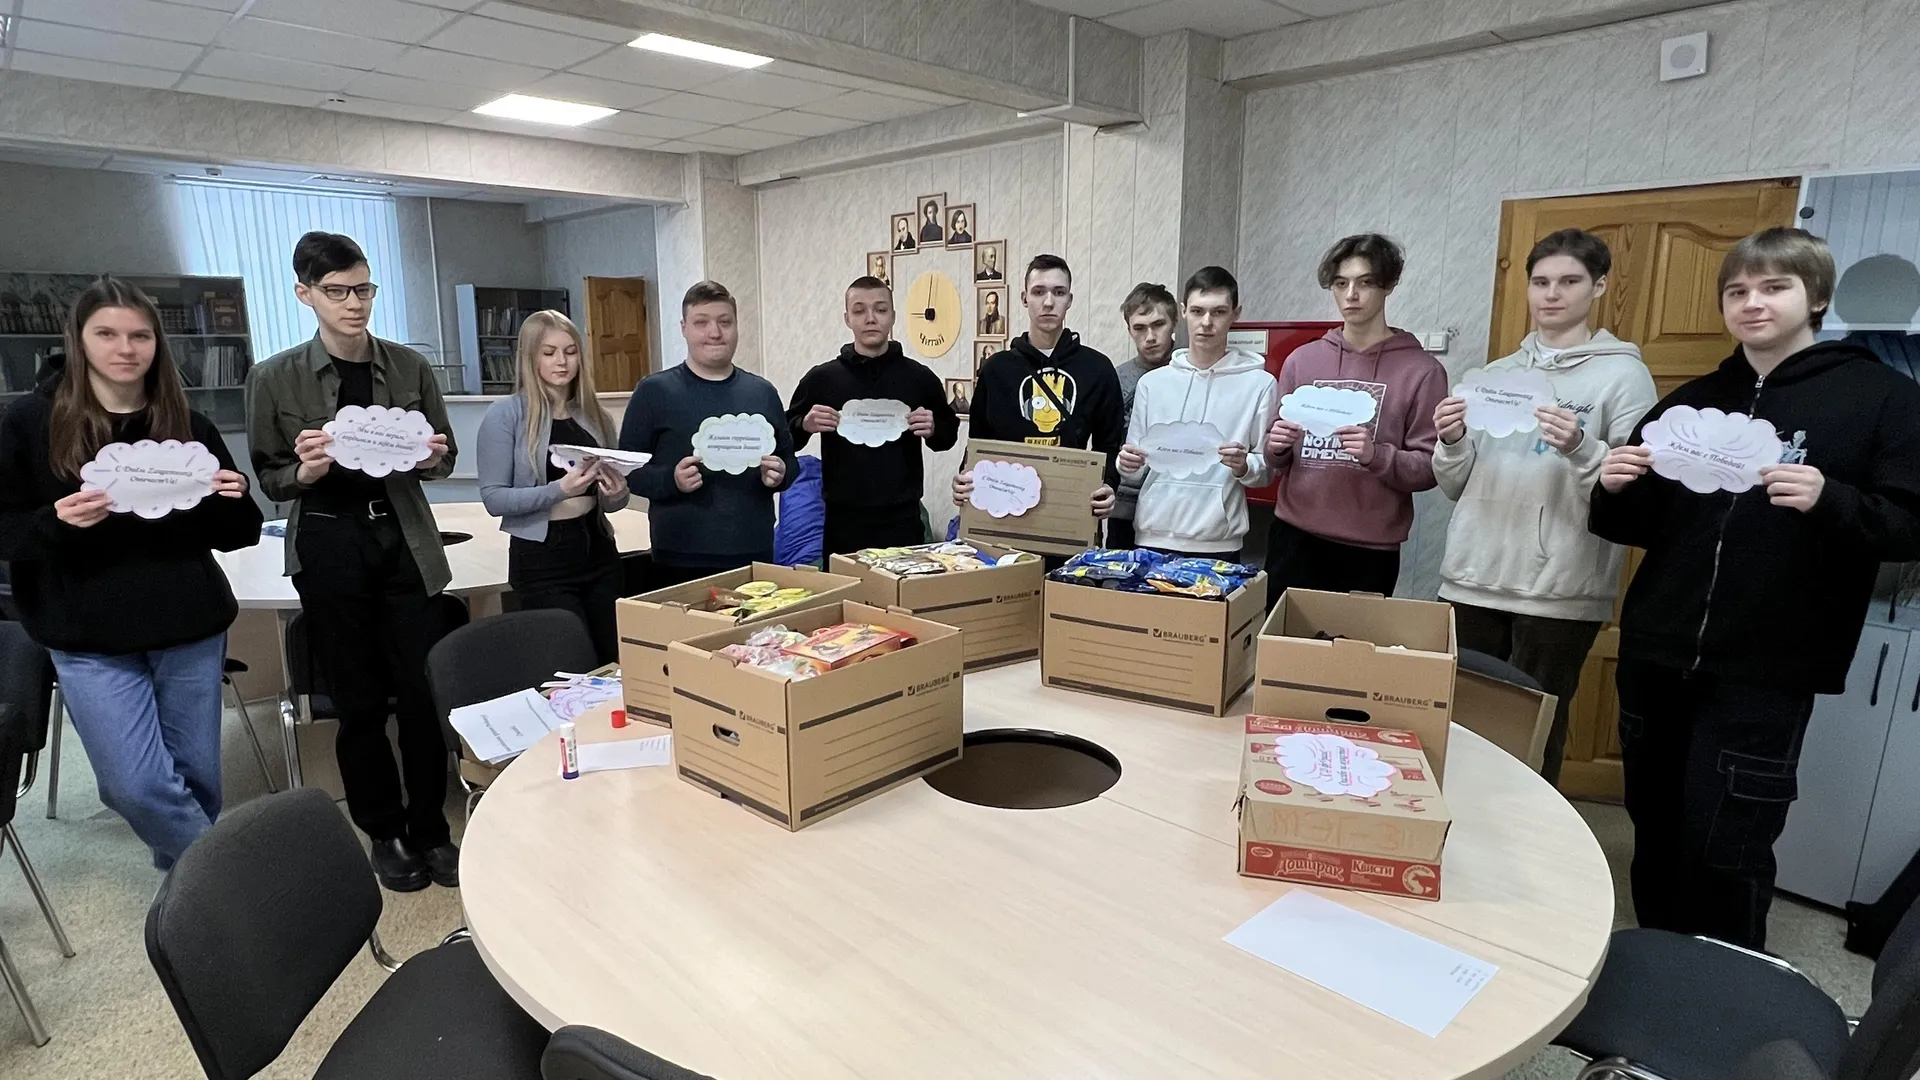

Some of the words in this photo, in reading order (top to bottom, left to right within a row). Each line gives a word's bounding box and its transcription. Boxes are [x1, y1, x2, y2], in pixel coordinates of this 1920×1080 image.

[919, 332, 945, 347] Читай
[1555, 396, 1595, 415] idnight
[1303, 434, 1331, 448] NOT
[1162, 631, 1205, 642] BRAUBERG
[916, 674, 950, 692] BRAUBERG
[1384, 695, 1429, 706] BRAUBERG
[746, 714, 774, 731] BRAUBERG
[1273, 857, 1344, 882] Доширак
[1351, 859, 1394, 877] Квисти
